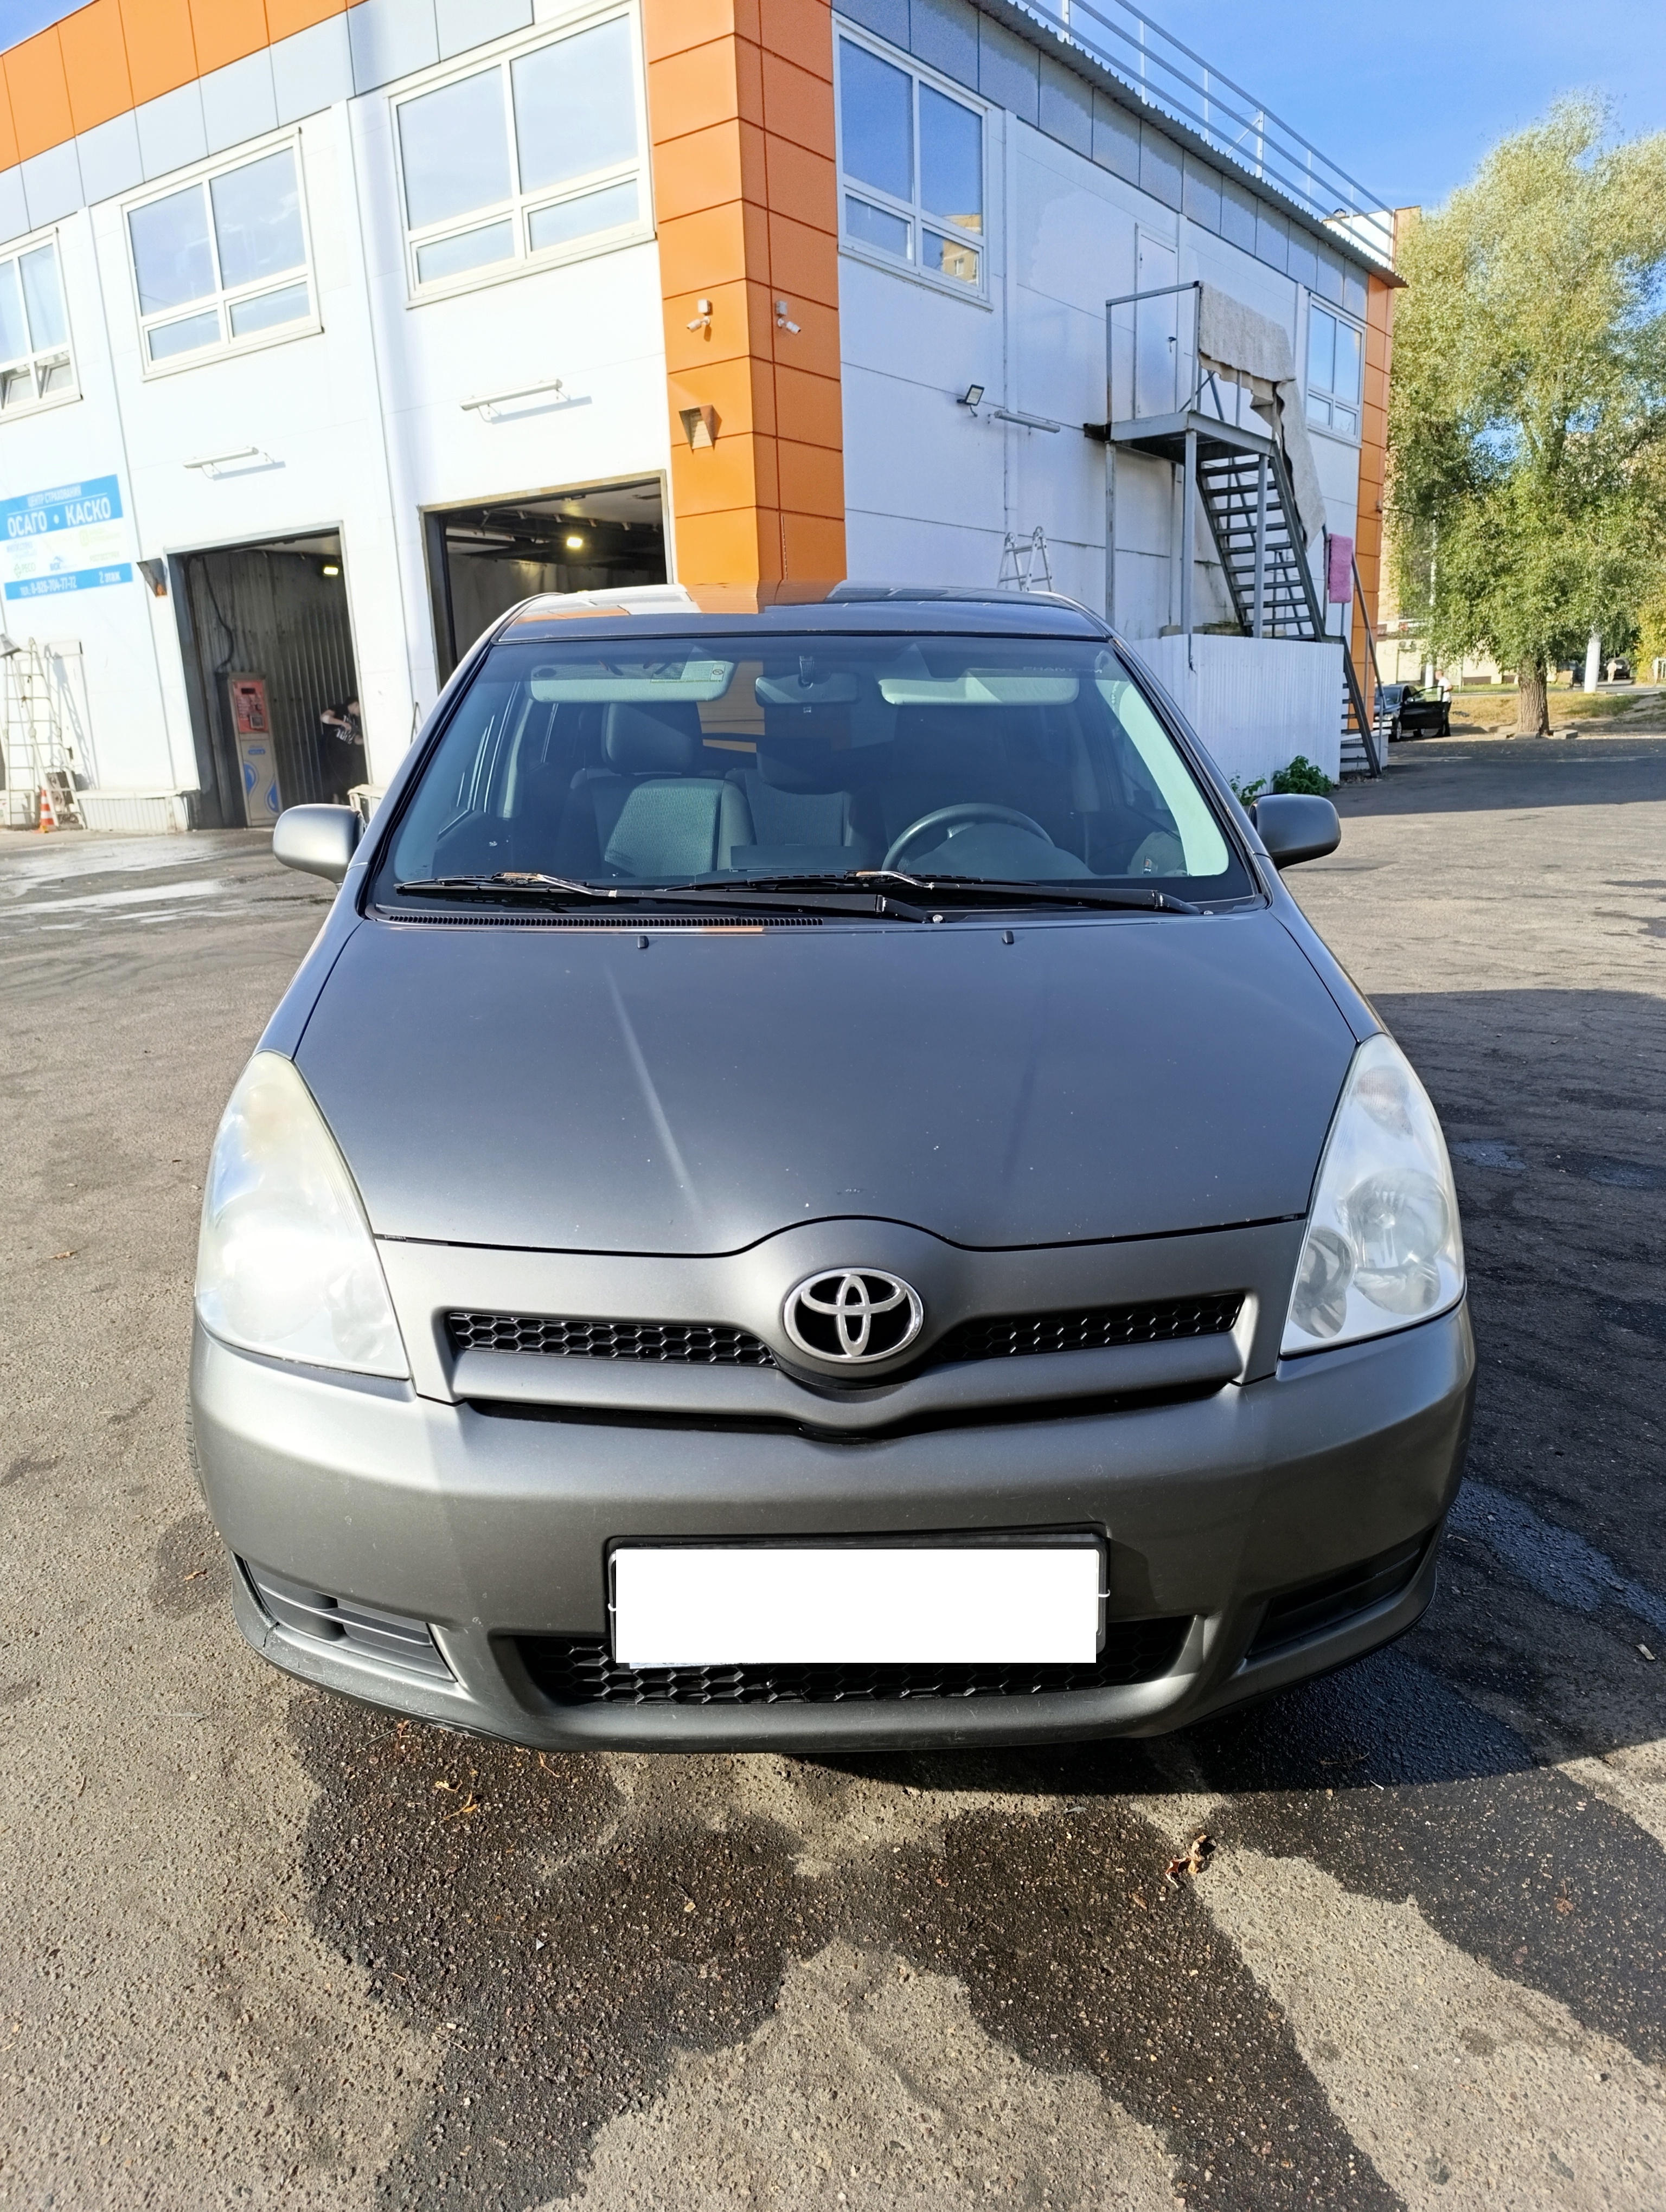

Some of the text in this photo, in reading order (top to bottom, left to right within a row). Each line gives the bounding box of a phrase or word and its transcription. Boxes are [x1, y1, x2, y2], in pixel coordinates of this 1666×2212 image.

[8, 497, 111, 537] ОСАГО КАСКО
[99, 571, 104, 584] 2
